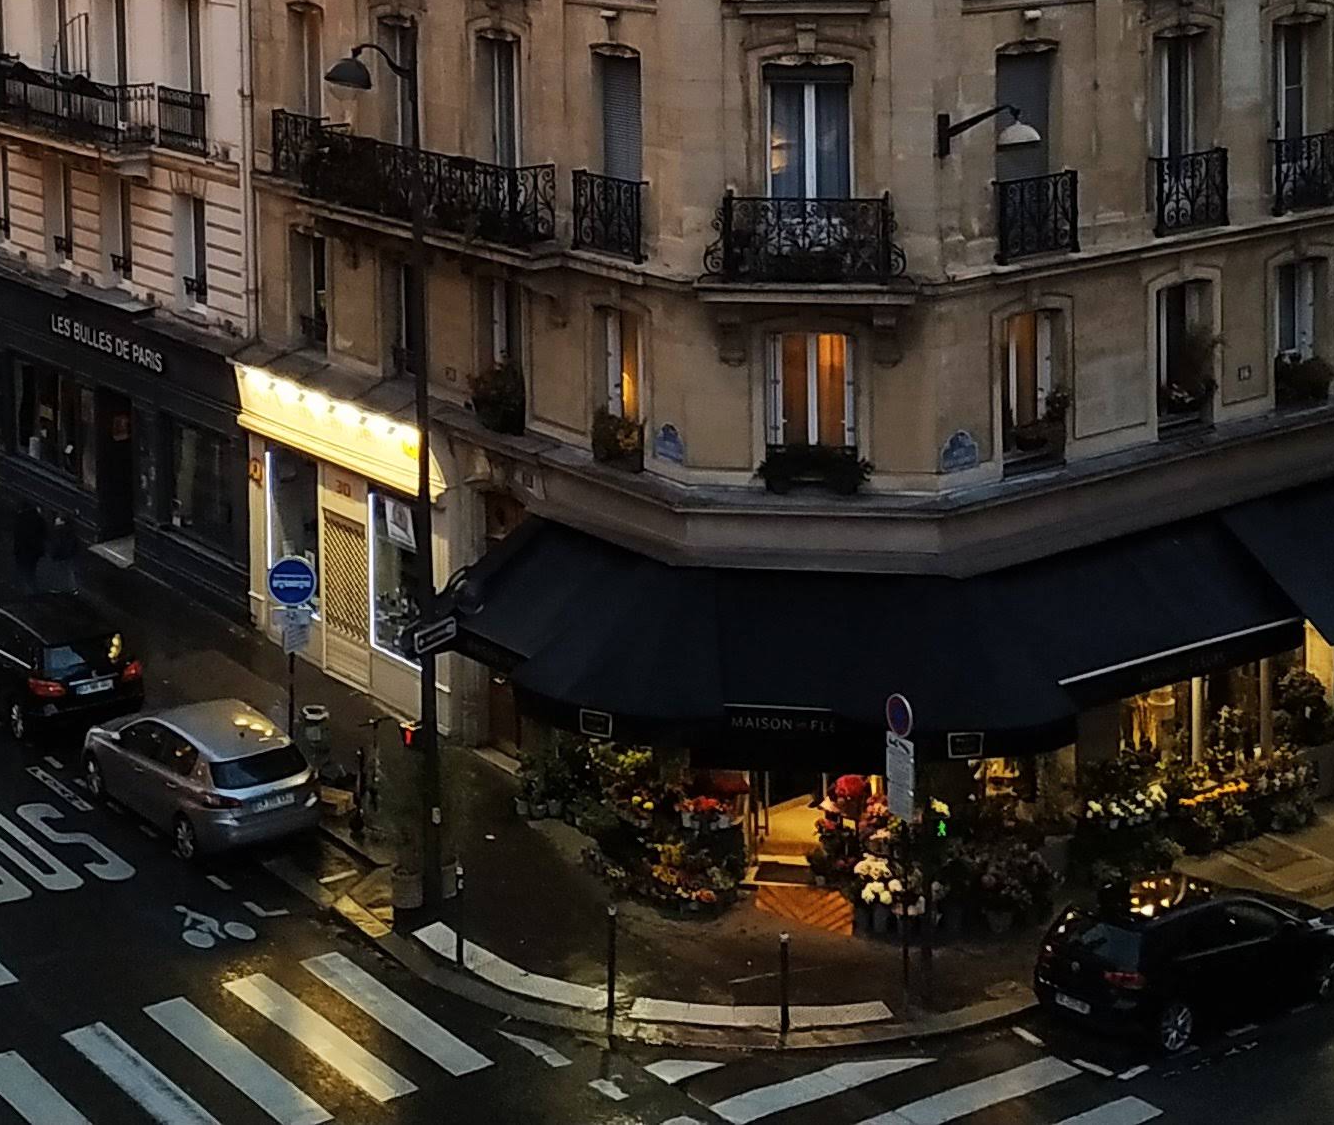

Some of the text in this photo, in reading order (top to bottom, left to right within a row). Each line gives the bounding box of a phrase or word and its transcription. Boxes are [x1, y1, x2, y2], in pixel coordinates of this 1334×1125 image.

[51, 313, 164, 373] LES BULLES DE PARIS
[335, 479, 352, 498] 30
[731, 715, 793, 731] MAISON
